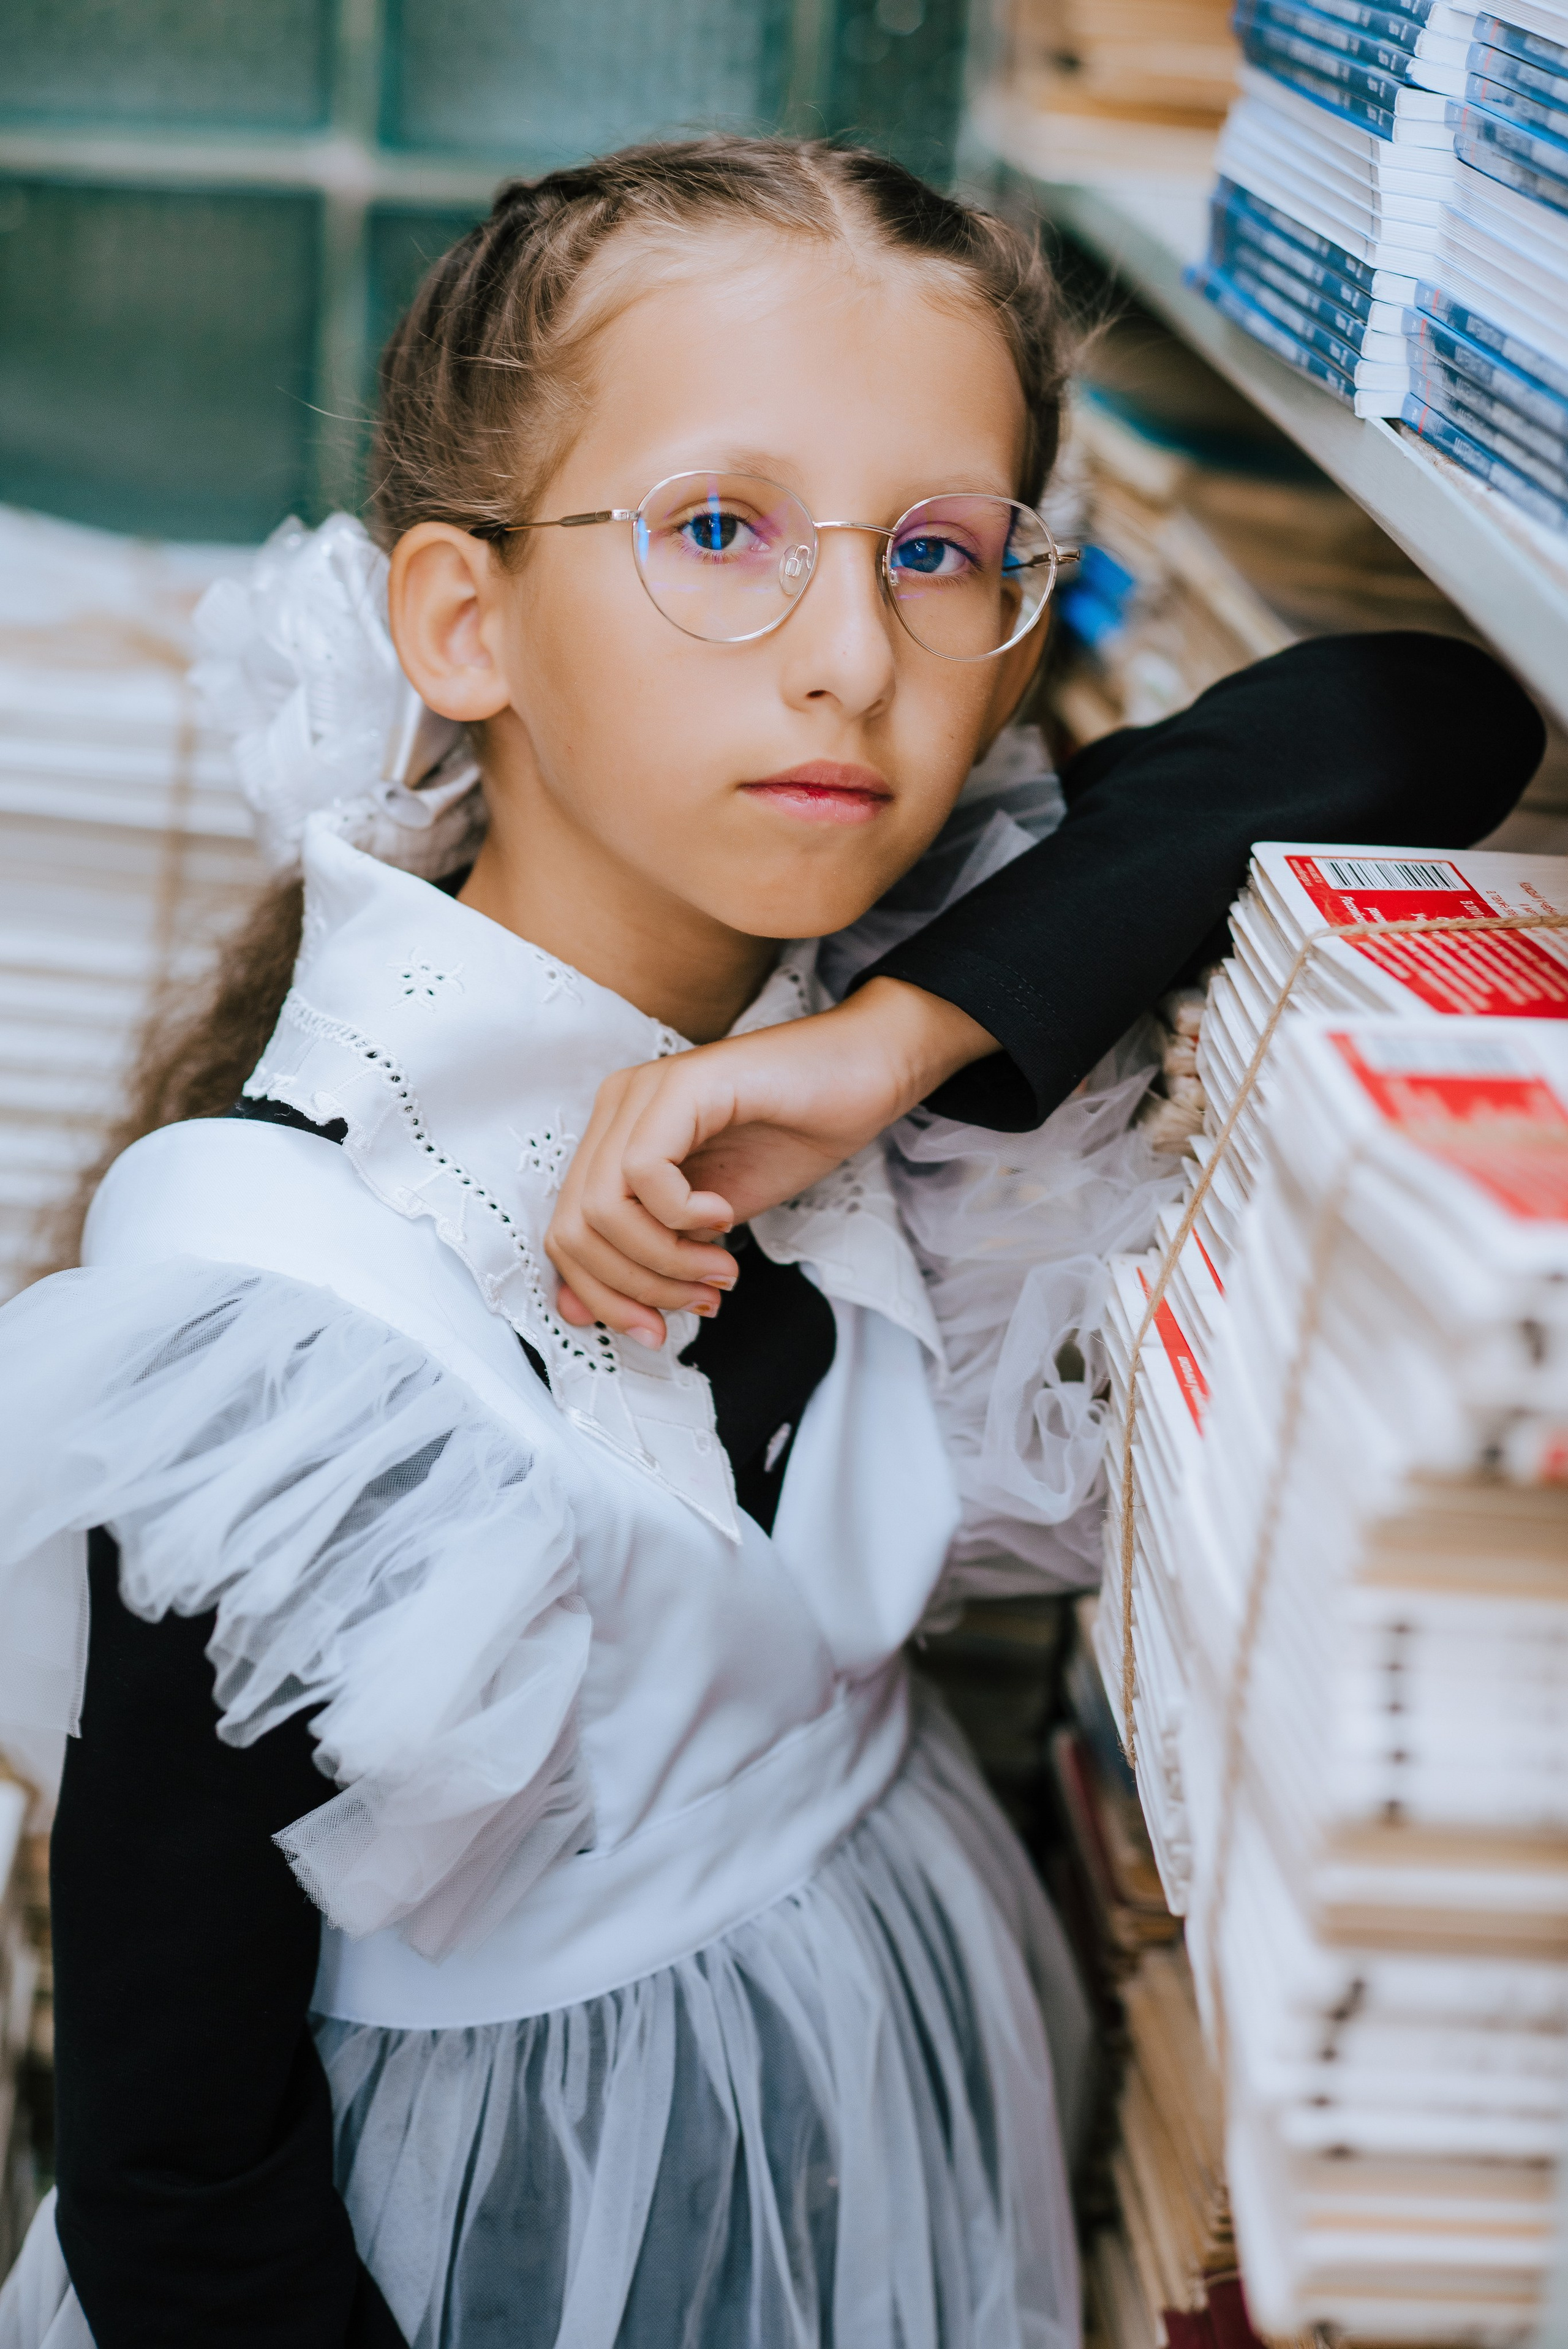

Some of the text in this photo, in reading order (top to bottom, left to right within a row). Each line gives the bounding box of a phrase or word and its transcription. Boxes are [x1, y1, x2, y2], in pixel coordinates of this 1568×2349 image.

[1338, 896, 1369, 924] Российско
[1362, 907, 1388, 924] реком
[1463, 905, 1485, 914] 2010
